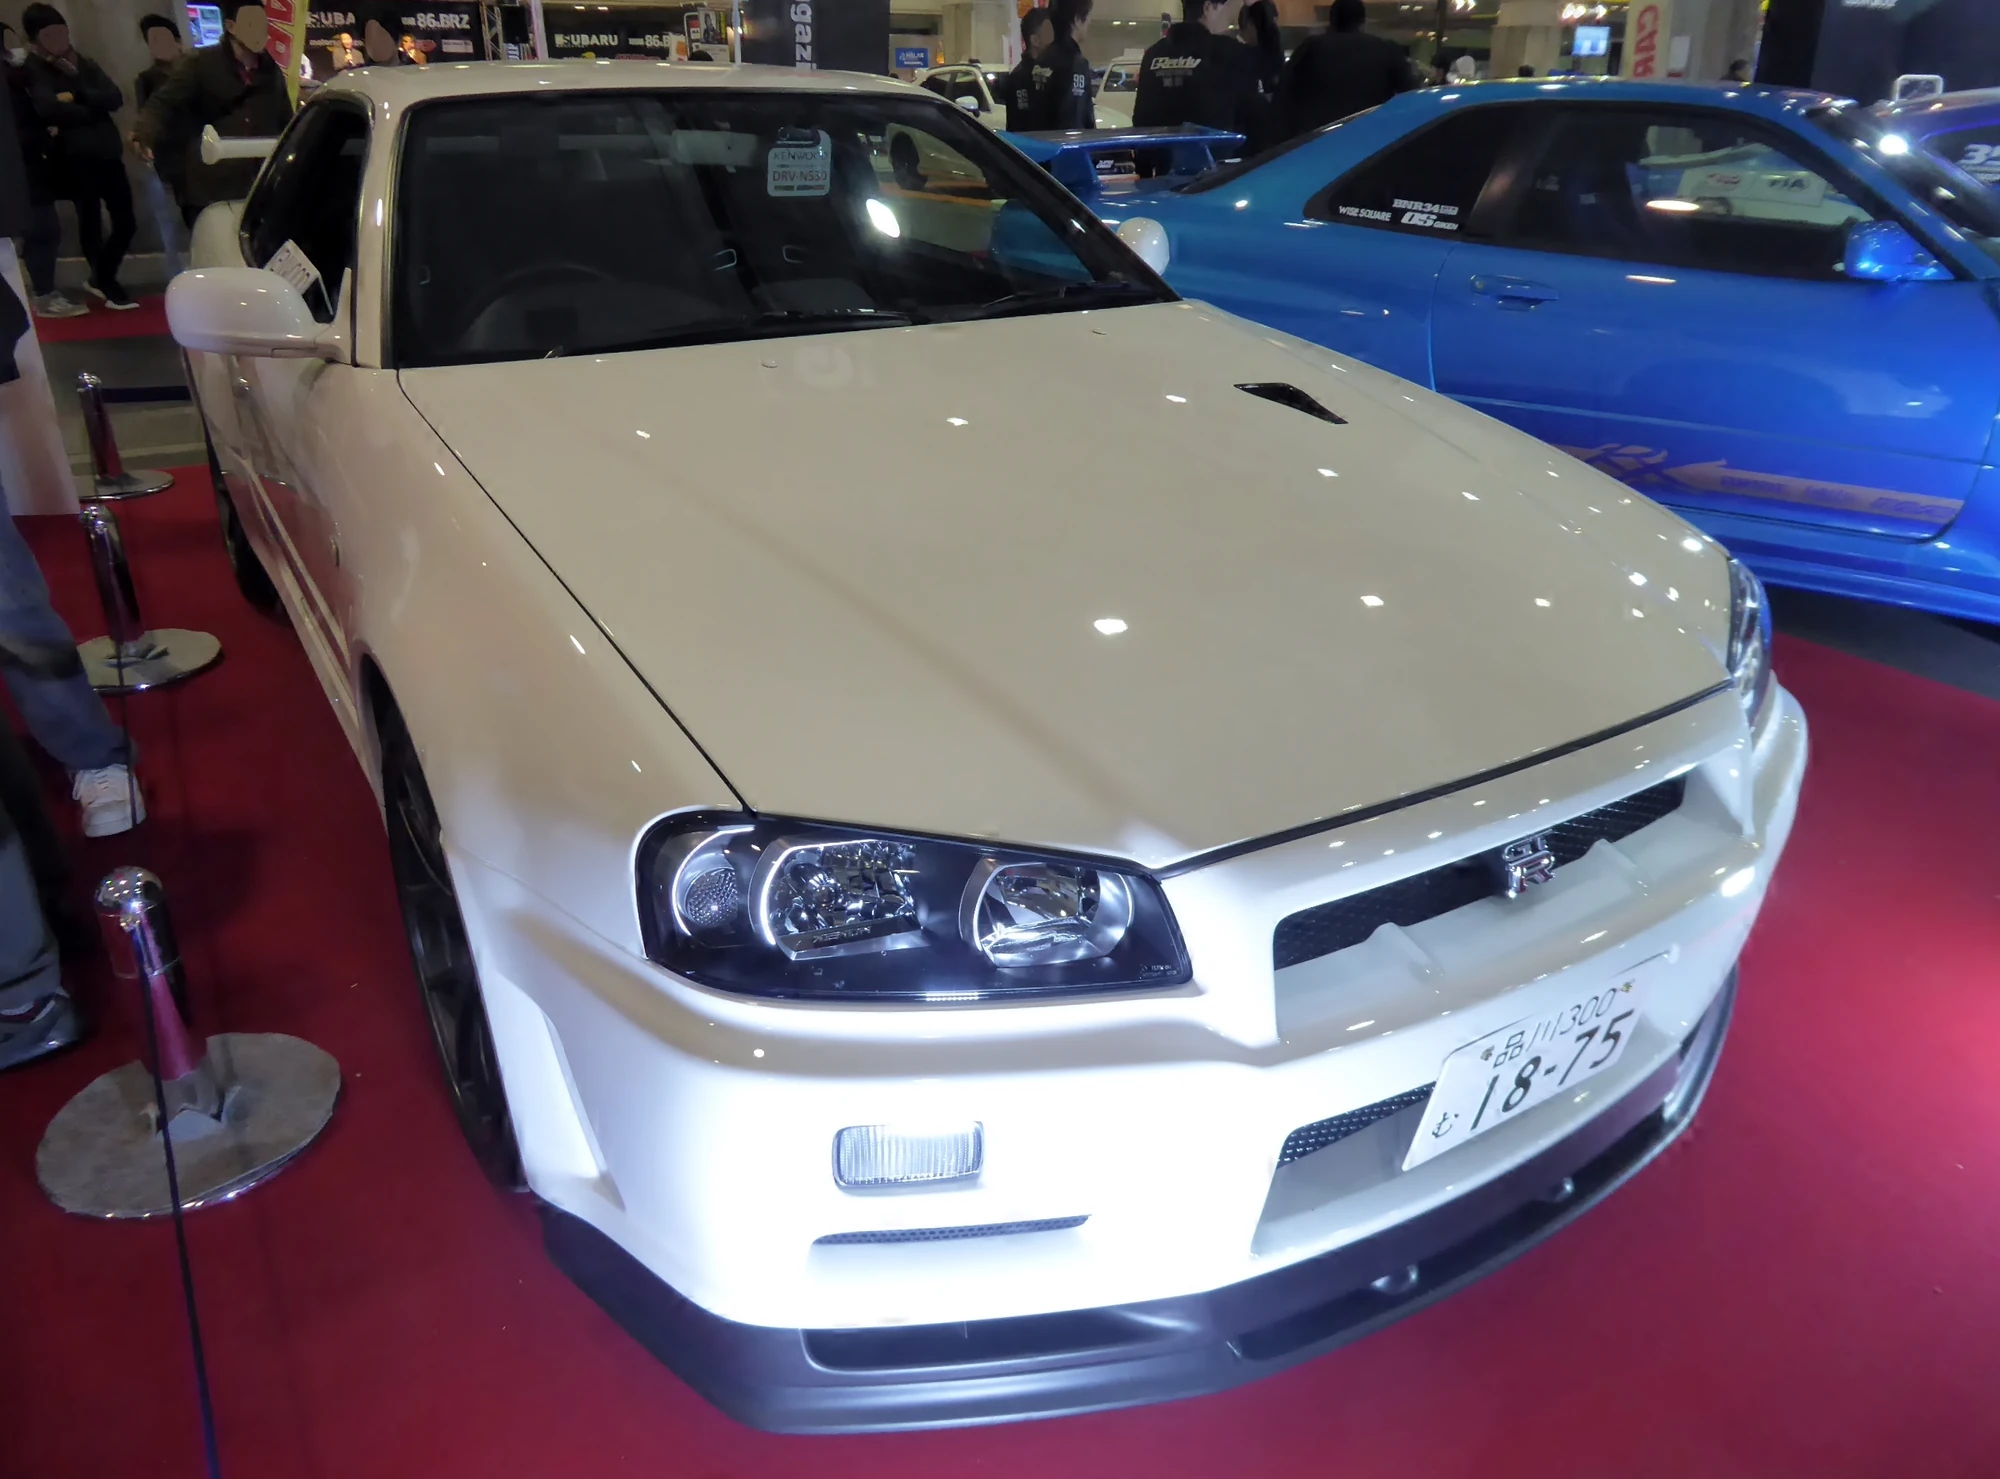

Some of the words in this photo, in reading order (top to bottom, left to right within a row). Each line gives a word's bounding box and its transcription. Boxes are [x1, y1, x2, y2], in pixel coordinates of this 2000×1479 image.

[561, 33, 619, 46] SUBARU
[790, 0, 817, 71] gazi
[1073, 74, 1085, 88] 99
[1560, 988, 1617, 1036] 300
[1470, 1008, 1635, 1132] 18-75
